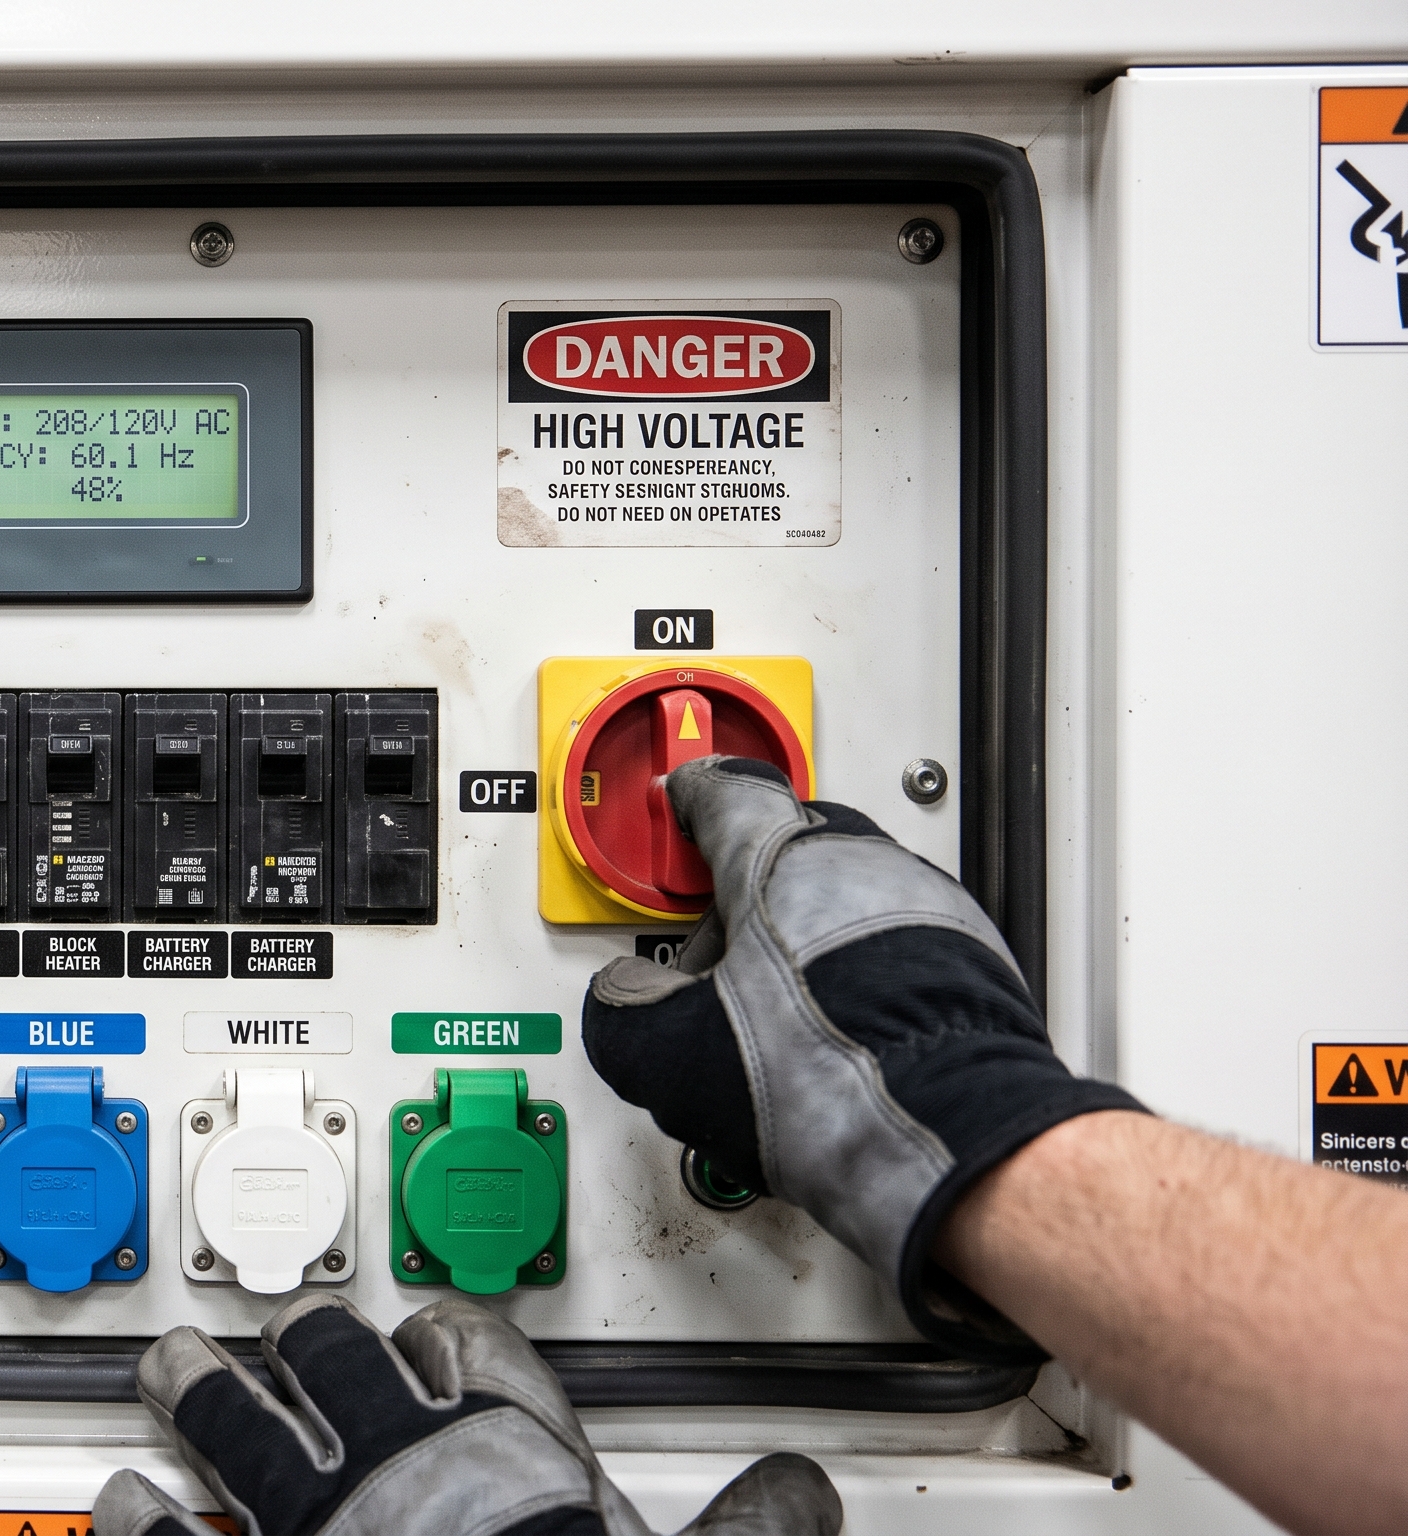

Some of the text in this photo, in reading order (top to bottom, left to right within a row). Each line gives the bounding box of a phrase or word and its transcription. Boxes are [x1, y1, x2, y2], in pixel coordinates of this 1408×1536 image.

[556, 335, 783, 378] DANGER
[36, 409, 176, 435] 208/120V
[196, 409, 229, 434] AC
[534, 413, 803, 449] HIGH VOLTAGE
[72, 443, 137, 468] 60.1
[161, 443, 193, 468] Hz
[564, 461, 584, 475] DO
[592, 460, 623, 475] NOT
[72, 477, 122, 501] 48%
[549, 484, 610, 498] SAFETY
[558, 506, 780, 521] DO NOT NEED ON OPETATES
[653, 617, 694, 643] ON
[471, 779, 526, 804] OFF
[50, 938, 96, 951] BLOCK
[146, 938, 209, 952] BATTERY
[251, 939, 314, 953] BATTERY
[46, 956, 100, 970] HEATER
[144, 956, 211, 970] CHARGER
[248, 957, 316, 971] CHARGER
[30, 1022, 93, 1046] BLUE
[227, 1021, 309, 1044] WHITE
[434, 1021, 518, 1045] GREEN
[1321, 1133, 1395, 1149] Sinicers
